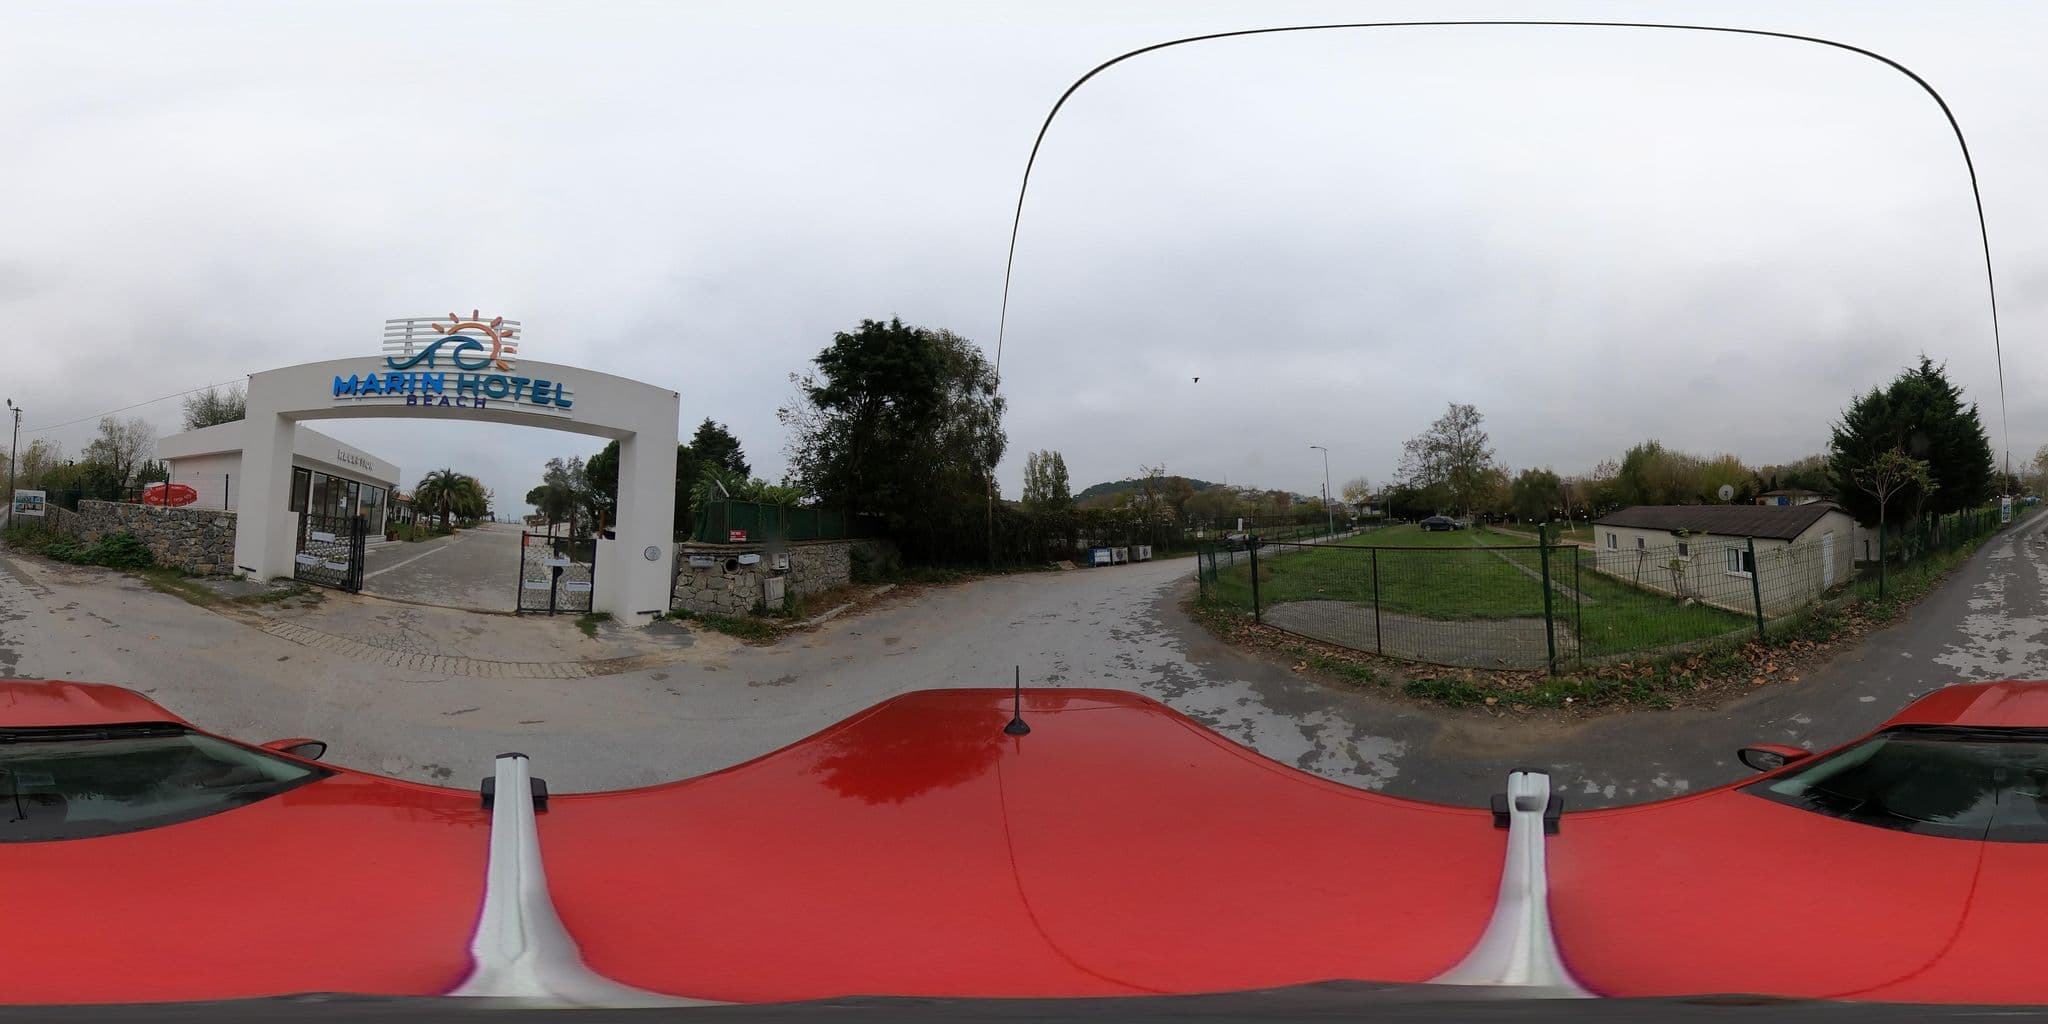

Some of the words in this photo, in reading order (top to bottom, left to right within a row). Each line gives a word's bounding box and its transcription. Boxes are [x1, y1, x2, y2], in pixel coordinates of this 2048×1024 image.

[333, 372, 444, 396] MARIN
[457, 373, 572, 408] HOTEL
[406, 394, 487, 409] BEACH
